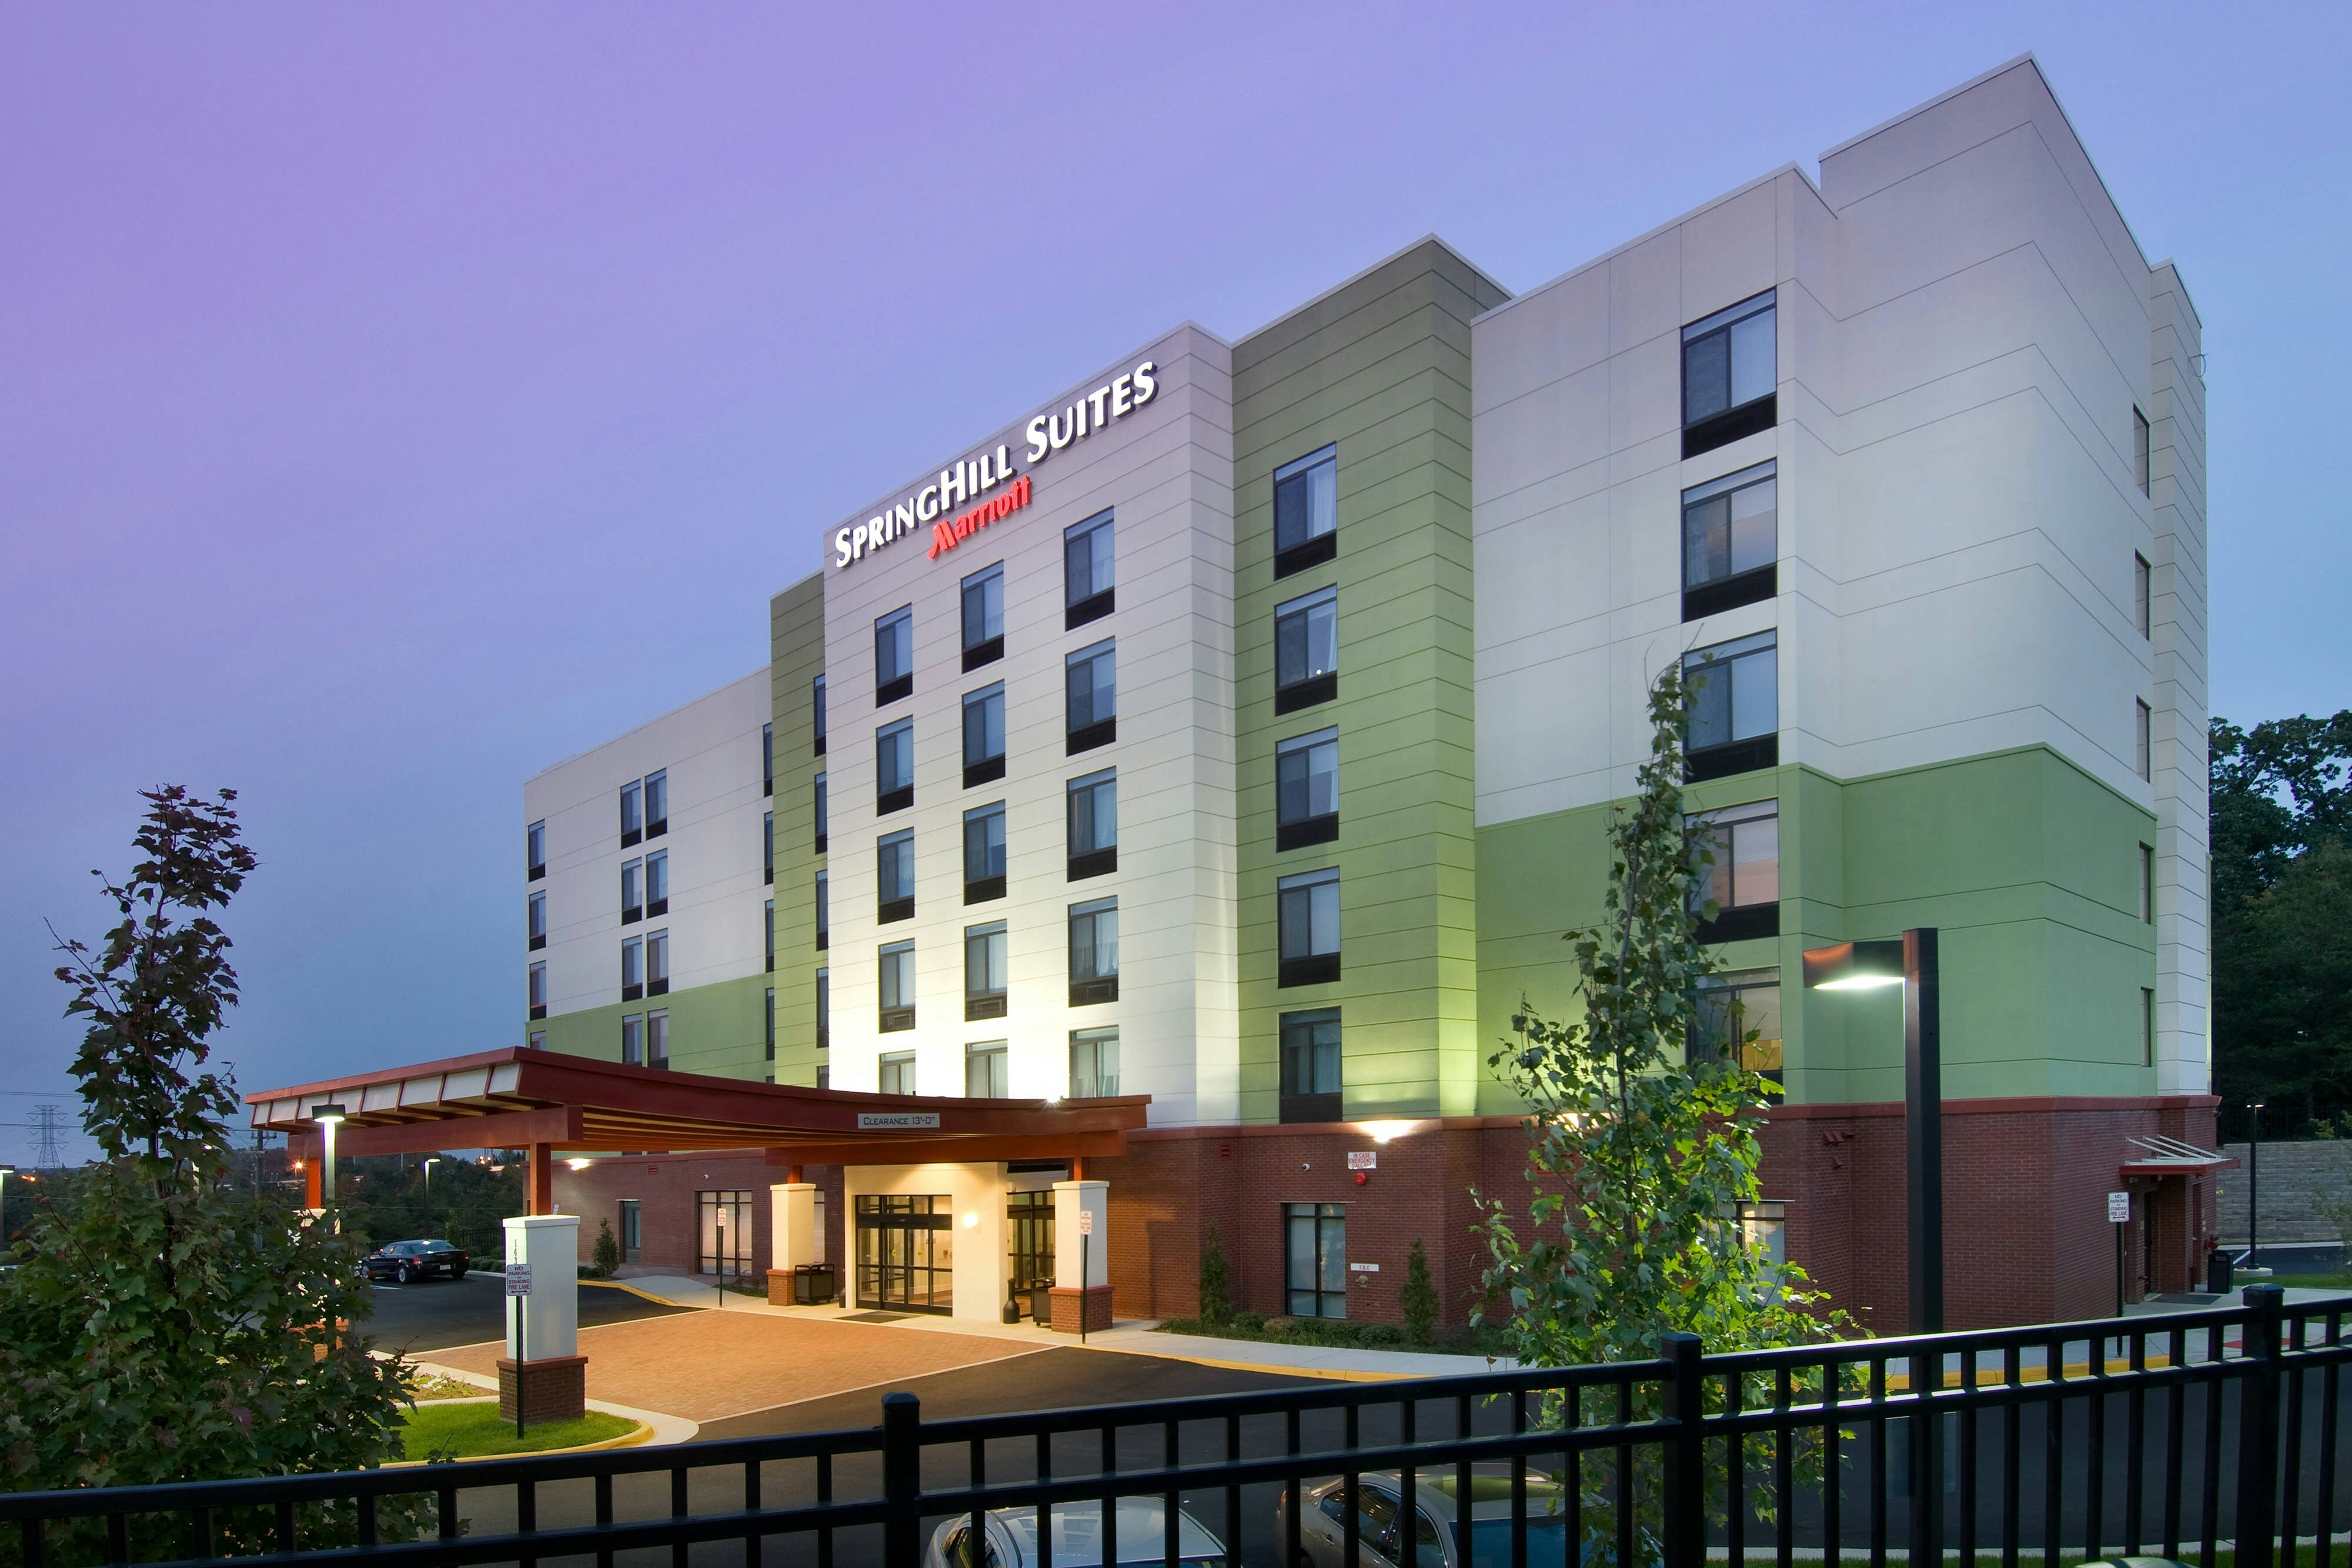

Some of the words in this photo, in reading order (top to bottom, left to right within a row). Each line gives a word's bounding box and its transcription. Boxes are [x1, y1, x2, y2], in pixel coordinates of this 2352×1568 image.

[835, 444, 1017, 568] SPRINGHILL
[1026, 361, 1159, 463] SUITES
[927, 475, 1031, 560] Marriott
[863, 1117, 908, 1125] CLEARANCE
